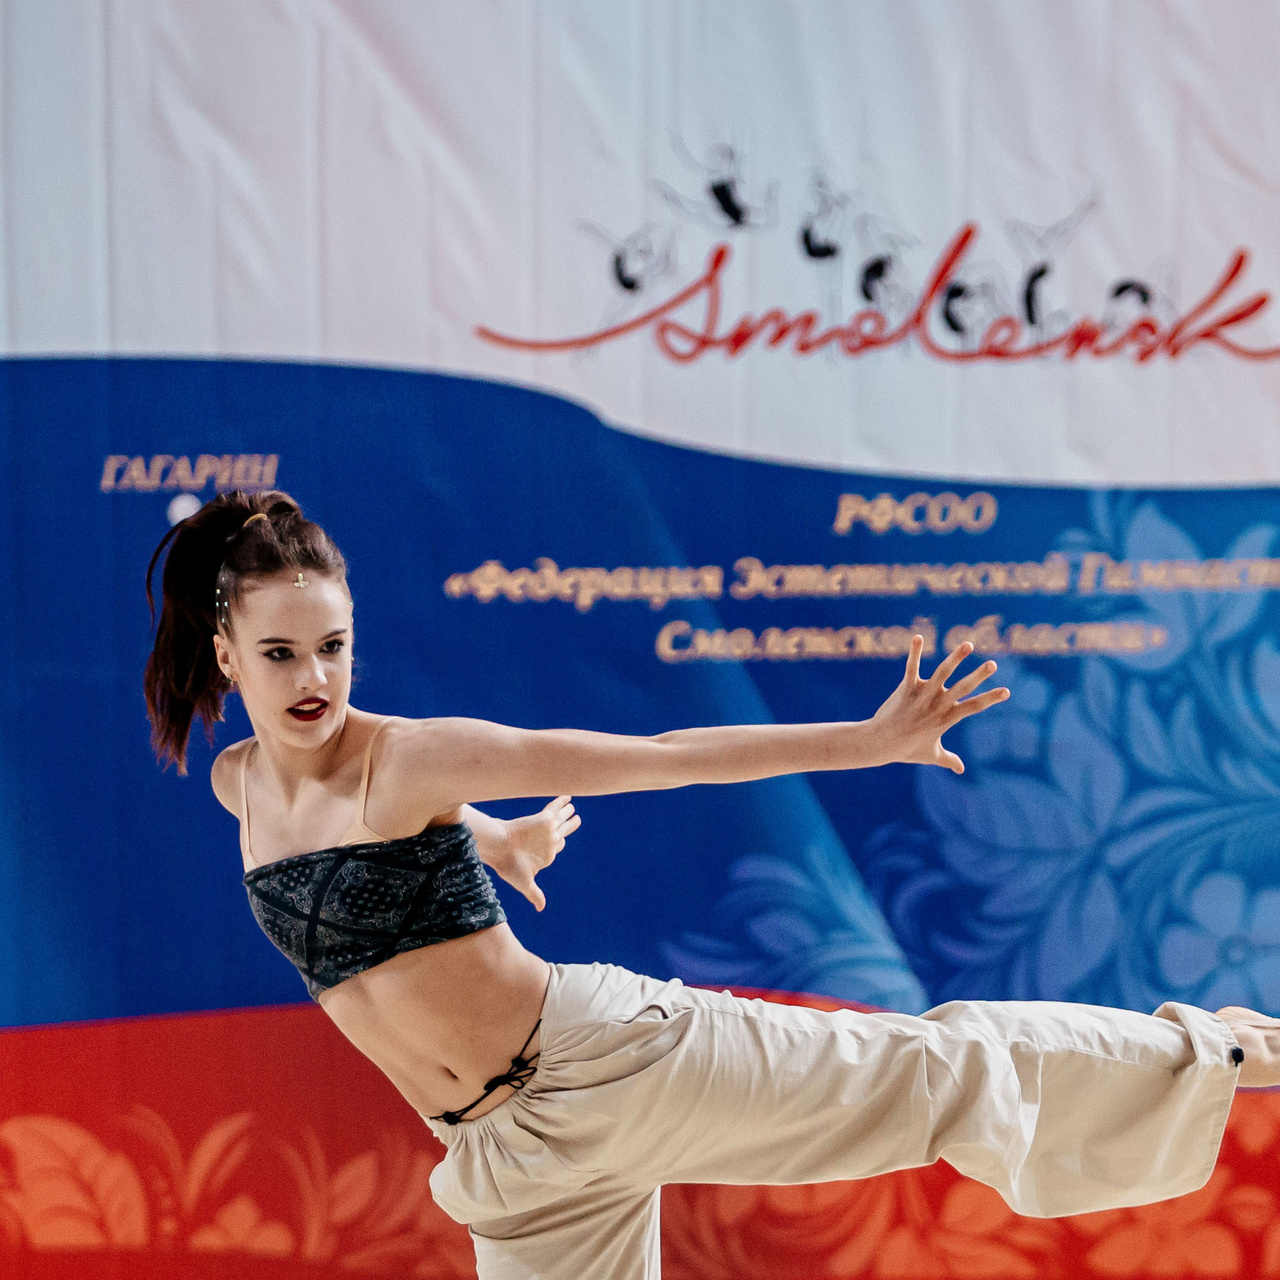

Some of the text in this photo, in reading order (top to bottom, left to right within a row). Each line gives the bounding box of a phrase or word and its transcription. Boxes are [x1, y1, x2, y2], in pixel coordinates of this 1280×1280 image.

[101, 454, 279, 492] ГАГАРИН
[833, 492, 998, 535] РФСОО
[654, 616, 936, 663] Смоленской
